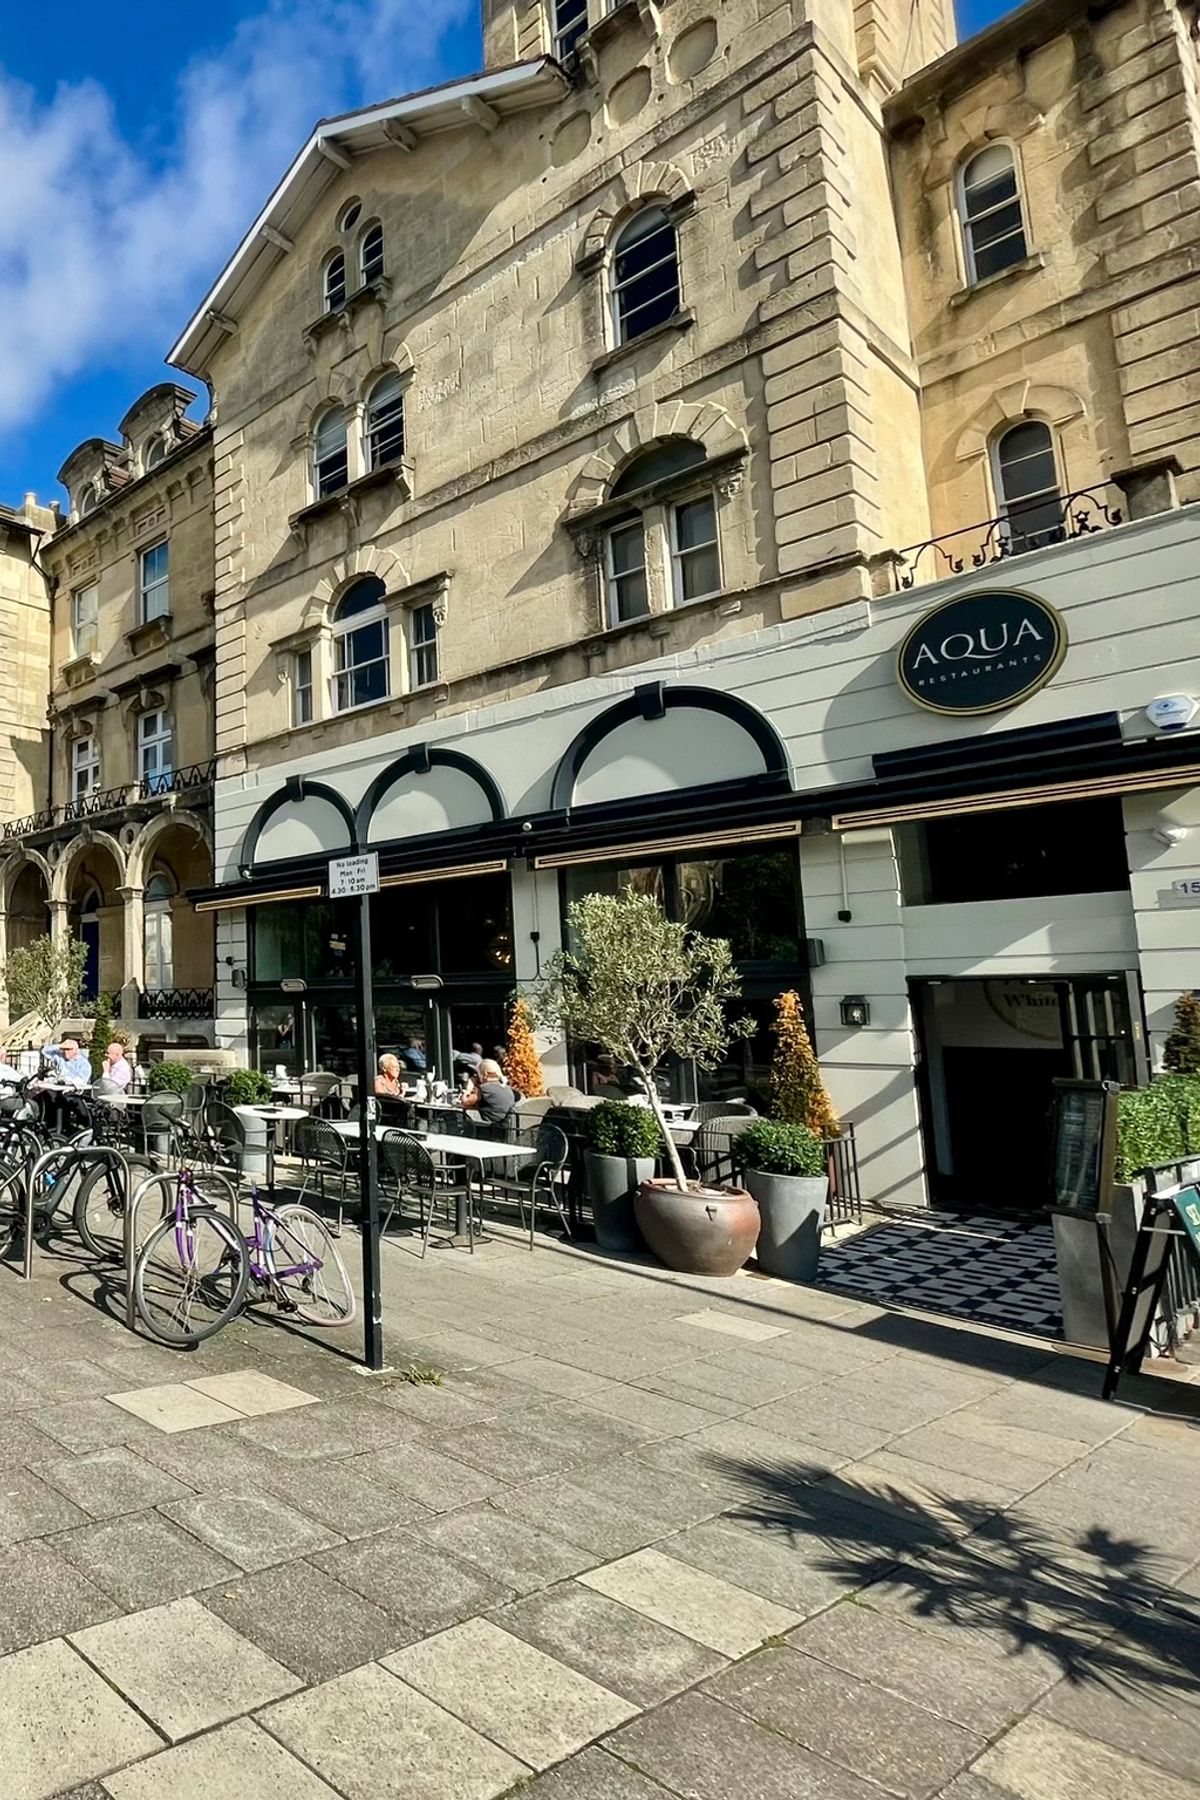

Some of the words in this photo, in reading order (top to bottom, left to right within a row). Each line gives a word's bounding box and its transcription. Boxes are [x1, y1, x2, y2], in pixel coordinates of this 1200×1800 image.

[912, 618, 1044, 670] AQUA
[918, 654, 1042, 687] RESTAURANTS
[346, 858, 369, 867] loading
